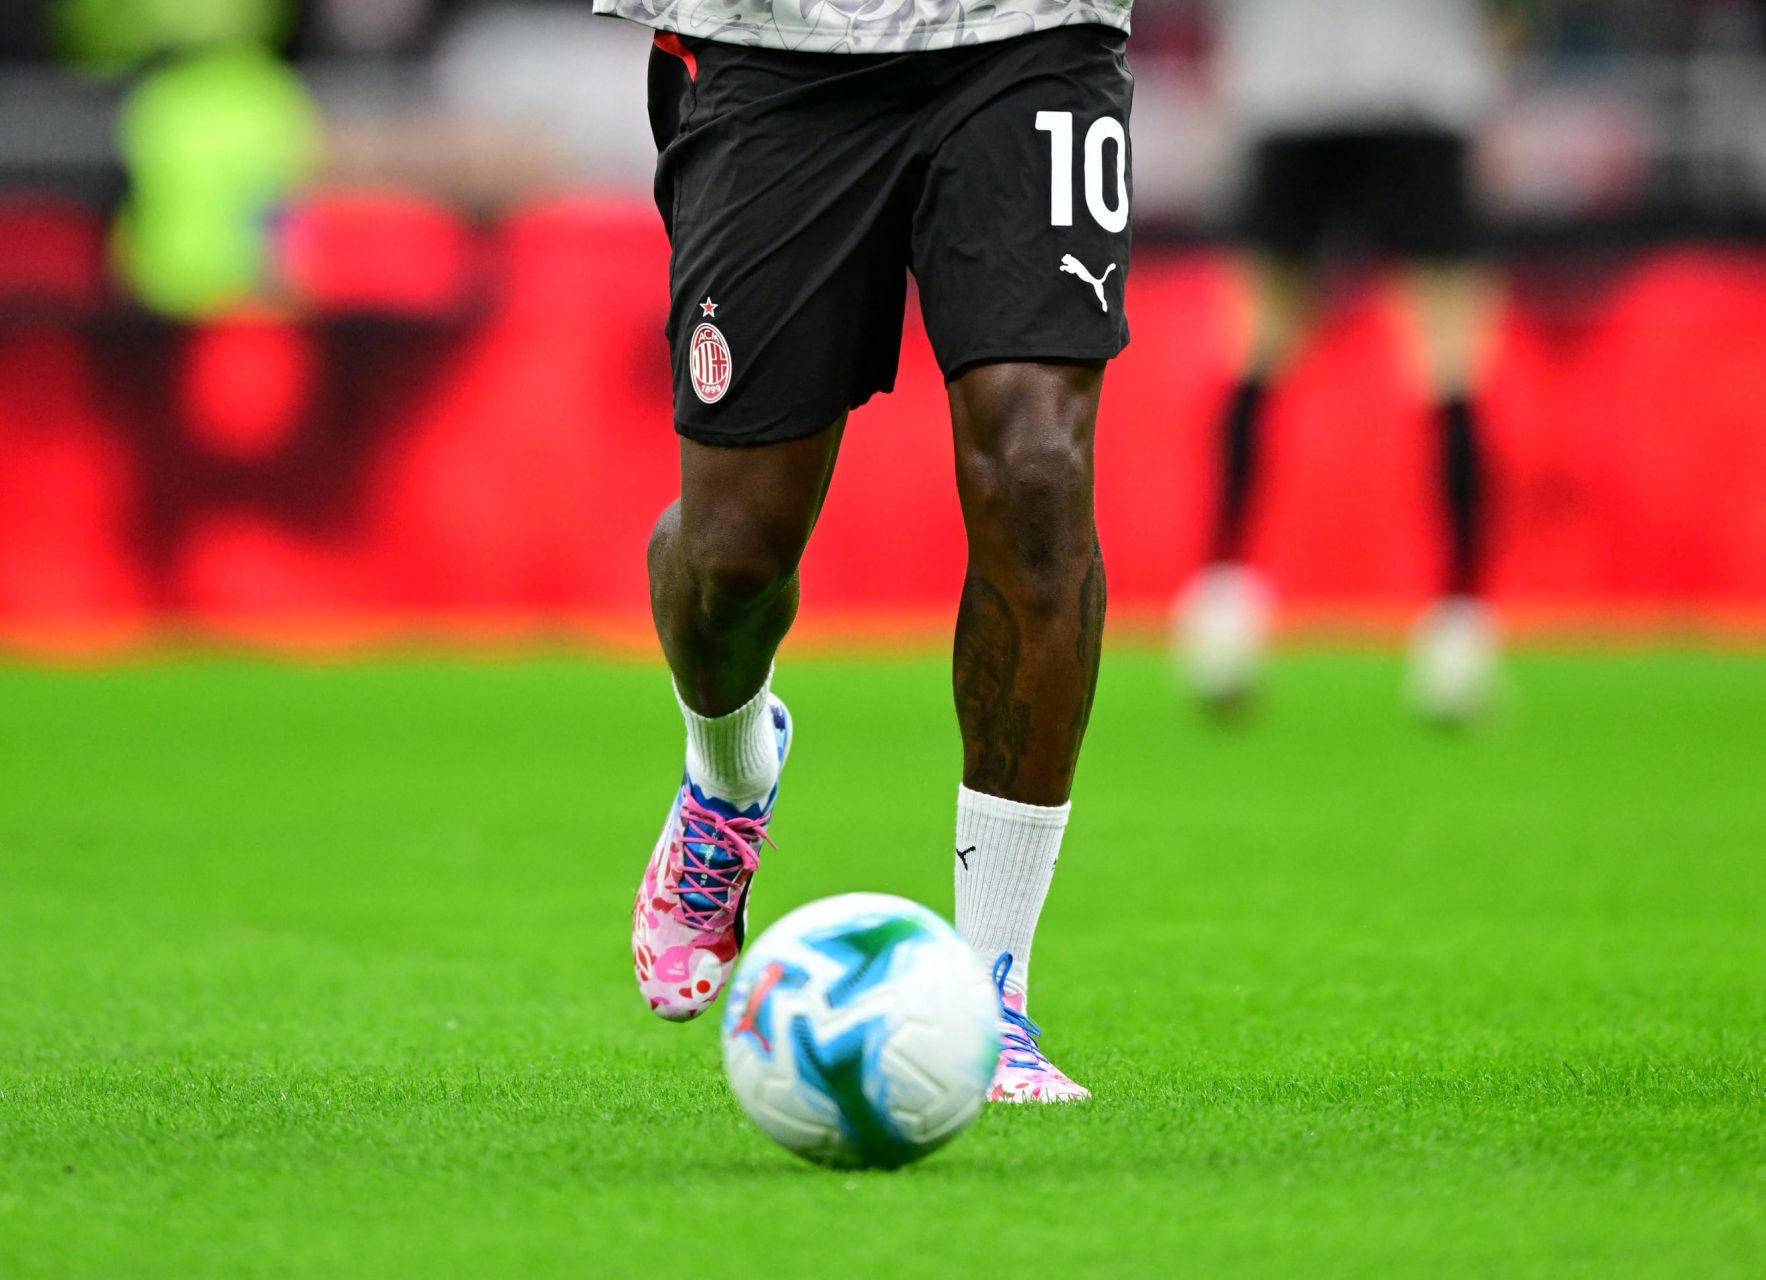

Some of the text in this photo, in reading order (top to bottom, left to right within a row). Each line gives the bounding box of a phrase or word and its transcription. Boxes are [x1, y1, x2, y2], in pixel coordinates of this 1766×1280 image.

[1035, 111, 1129, 233] 10
[698, 329, 720, 344] ACM
[702, 384, 721, 394] 1899
